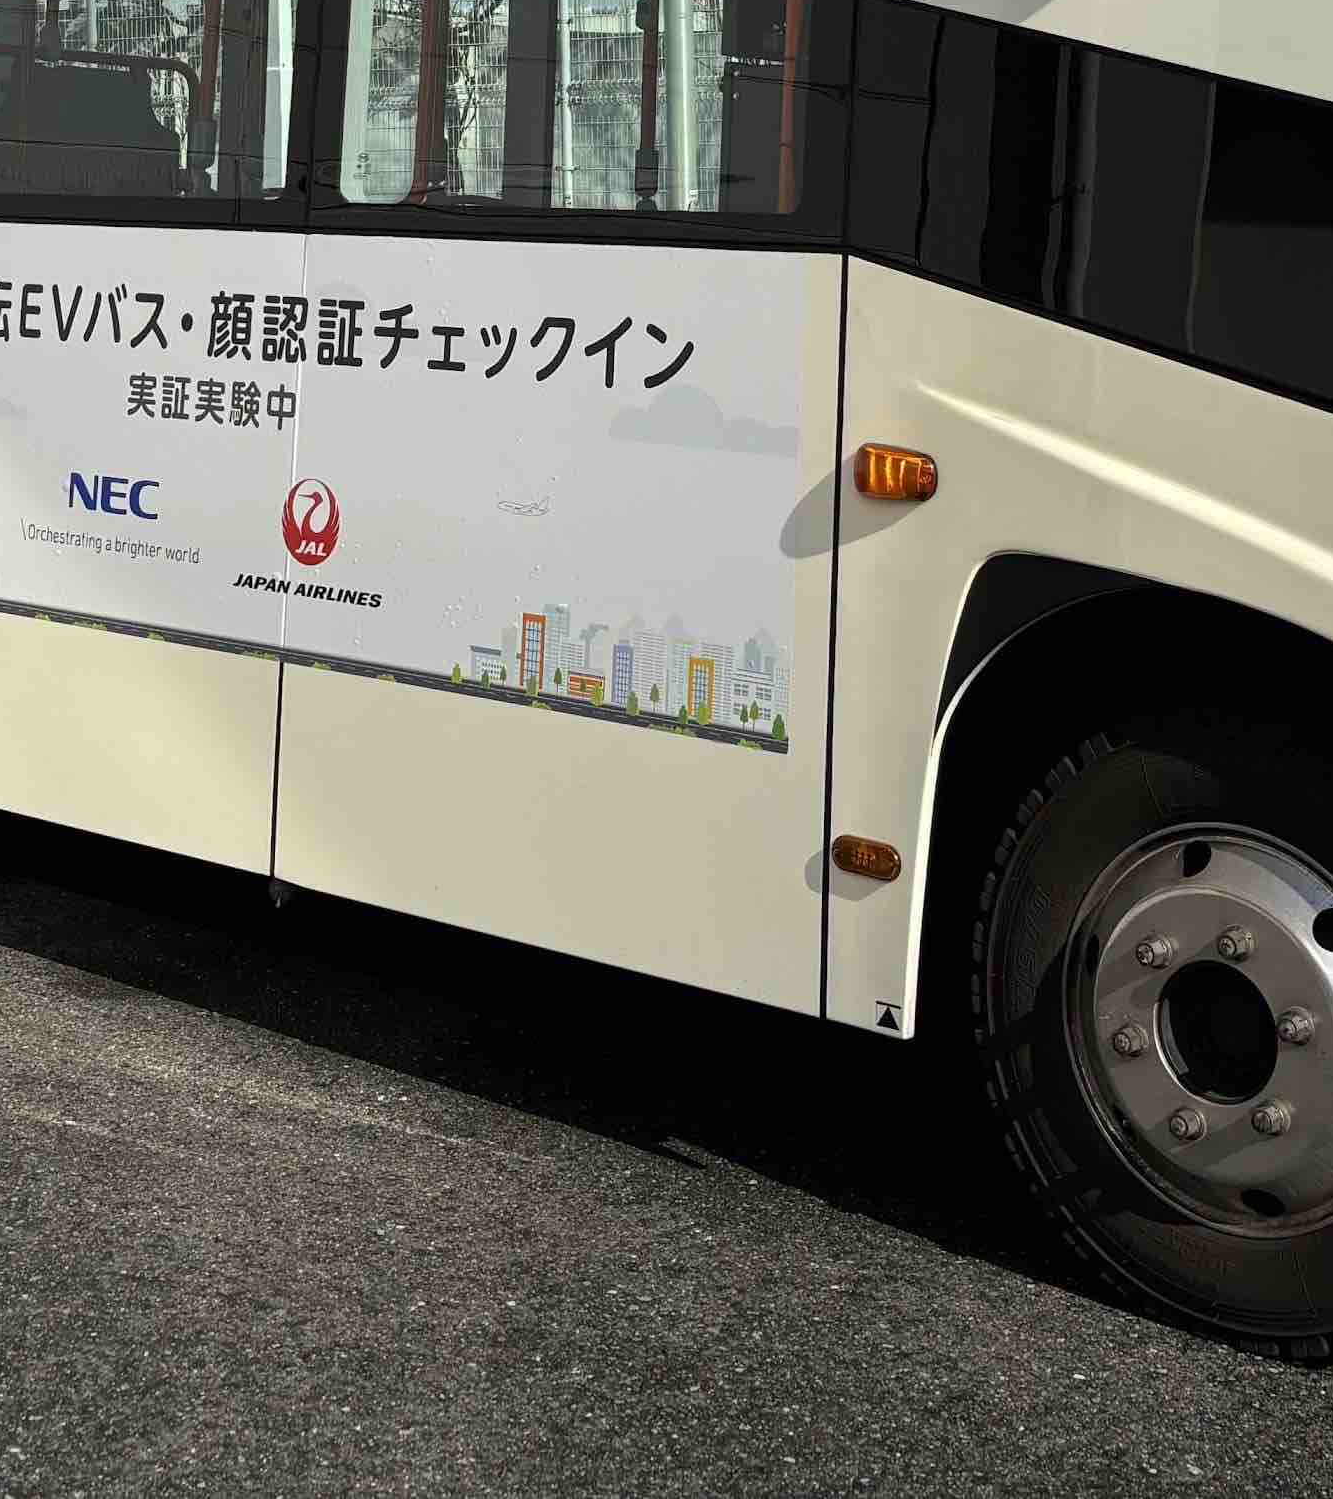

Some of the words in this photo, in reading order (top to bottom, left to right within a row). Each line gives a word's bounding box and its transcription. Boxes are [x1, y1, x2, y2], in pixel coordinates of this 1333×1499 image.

[126, 372, 296, 431] 実証実験中
[68, 472, 160, 520] NEC
[105, 539, 112, 551] a
[115, 534, 162, 559] brighter
[165, 546, 199, 564] world
[295, 539, 327, 557] JAL
[232, 573, 291, 594] JAPAN
[293, 583, 383, 608] AIRLINES
